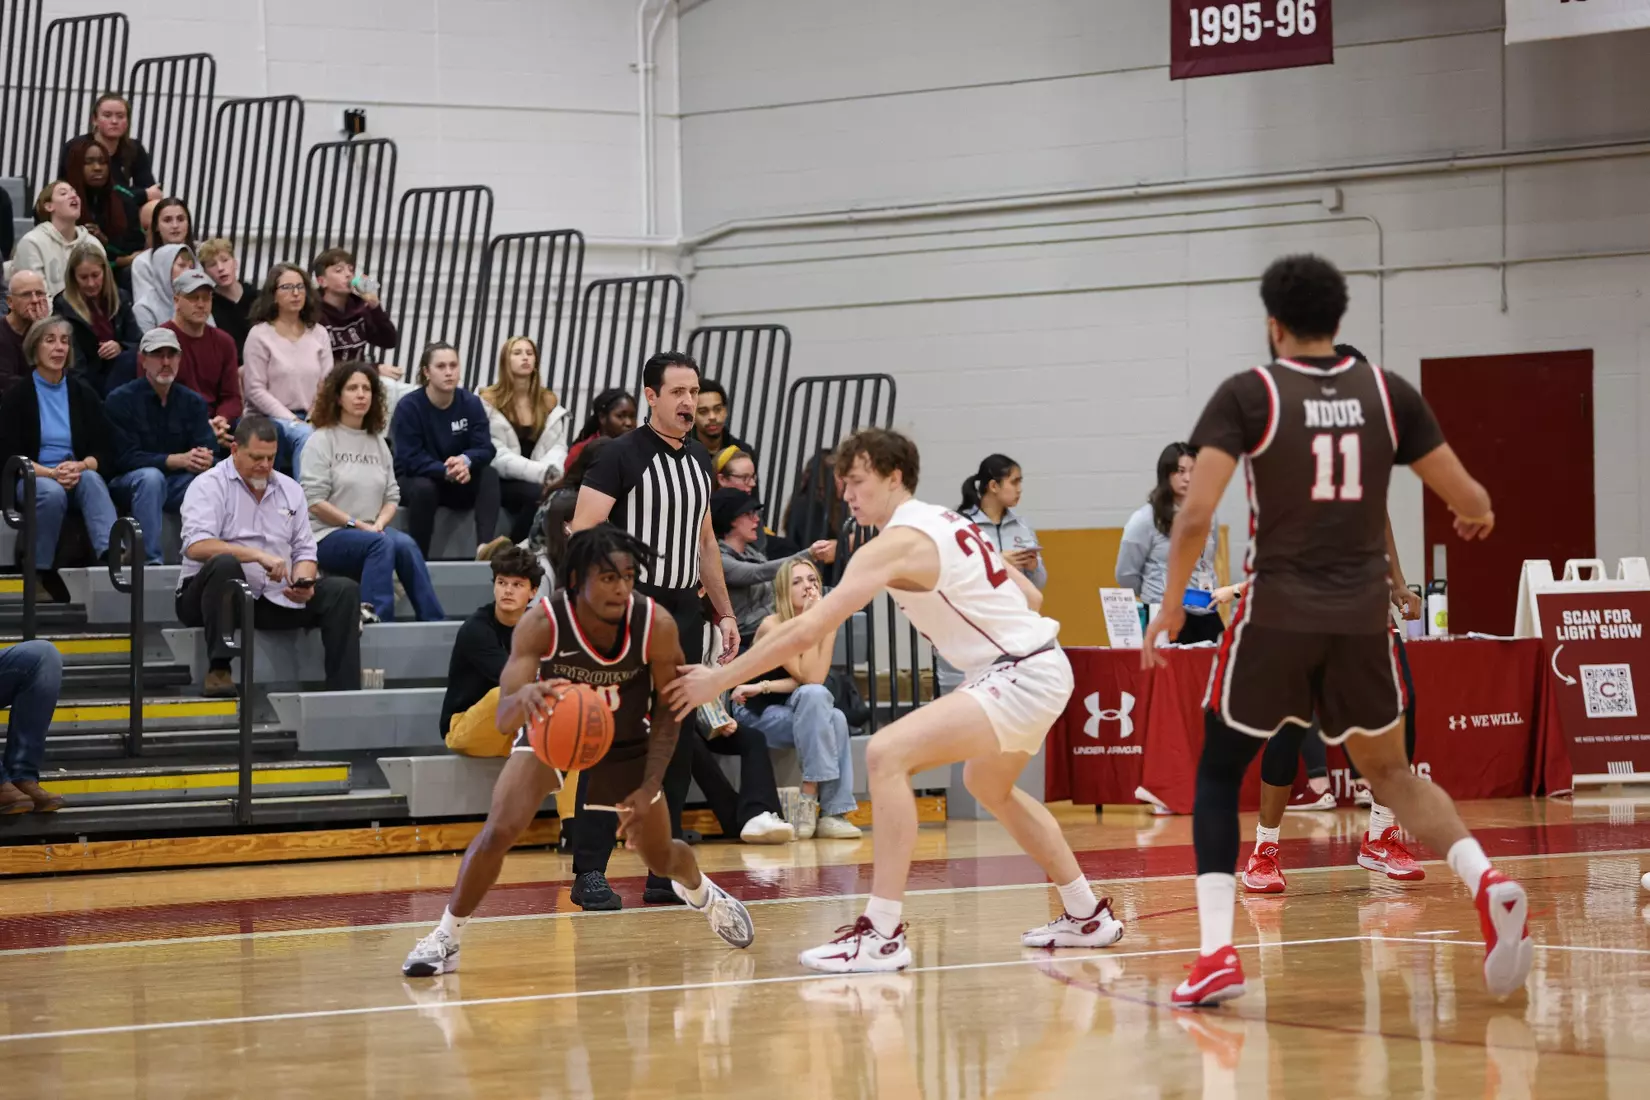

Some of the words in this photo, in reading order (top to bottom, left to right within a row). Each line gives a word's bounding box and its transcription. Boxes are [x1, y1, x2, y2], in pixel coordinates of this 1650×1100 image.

[1189, 0, 1317, 47] 1995-96
[1310, 432, 1364, 501] 11
[1562, 610, 1601, 625] SCAN
[1603, 608, 1632, 624] FOR
[1556, 624, 1596, 641] LIGHT
[1599, 623, 1642, 639] SHOW
[1470, 715, 1490, 728] WE
[1073, 746, 1105, 755] UNDER
[1107, 745, 1142, 755] ARMOUR
